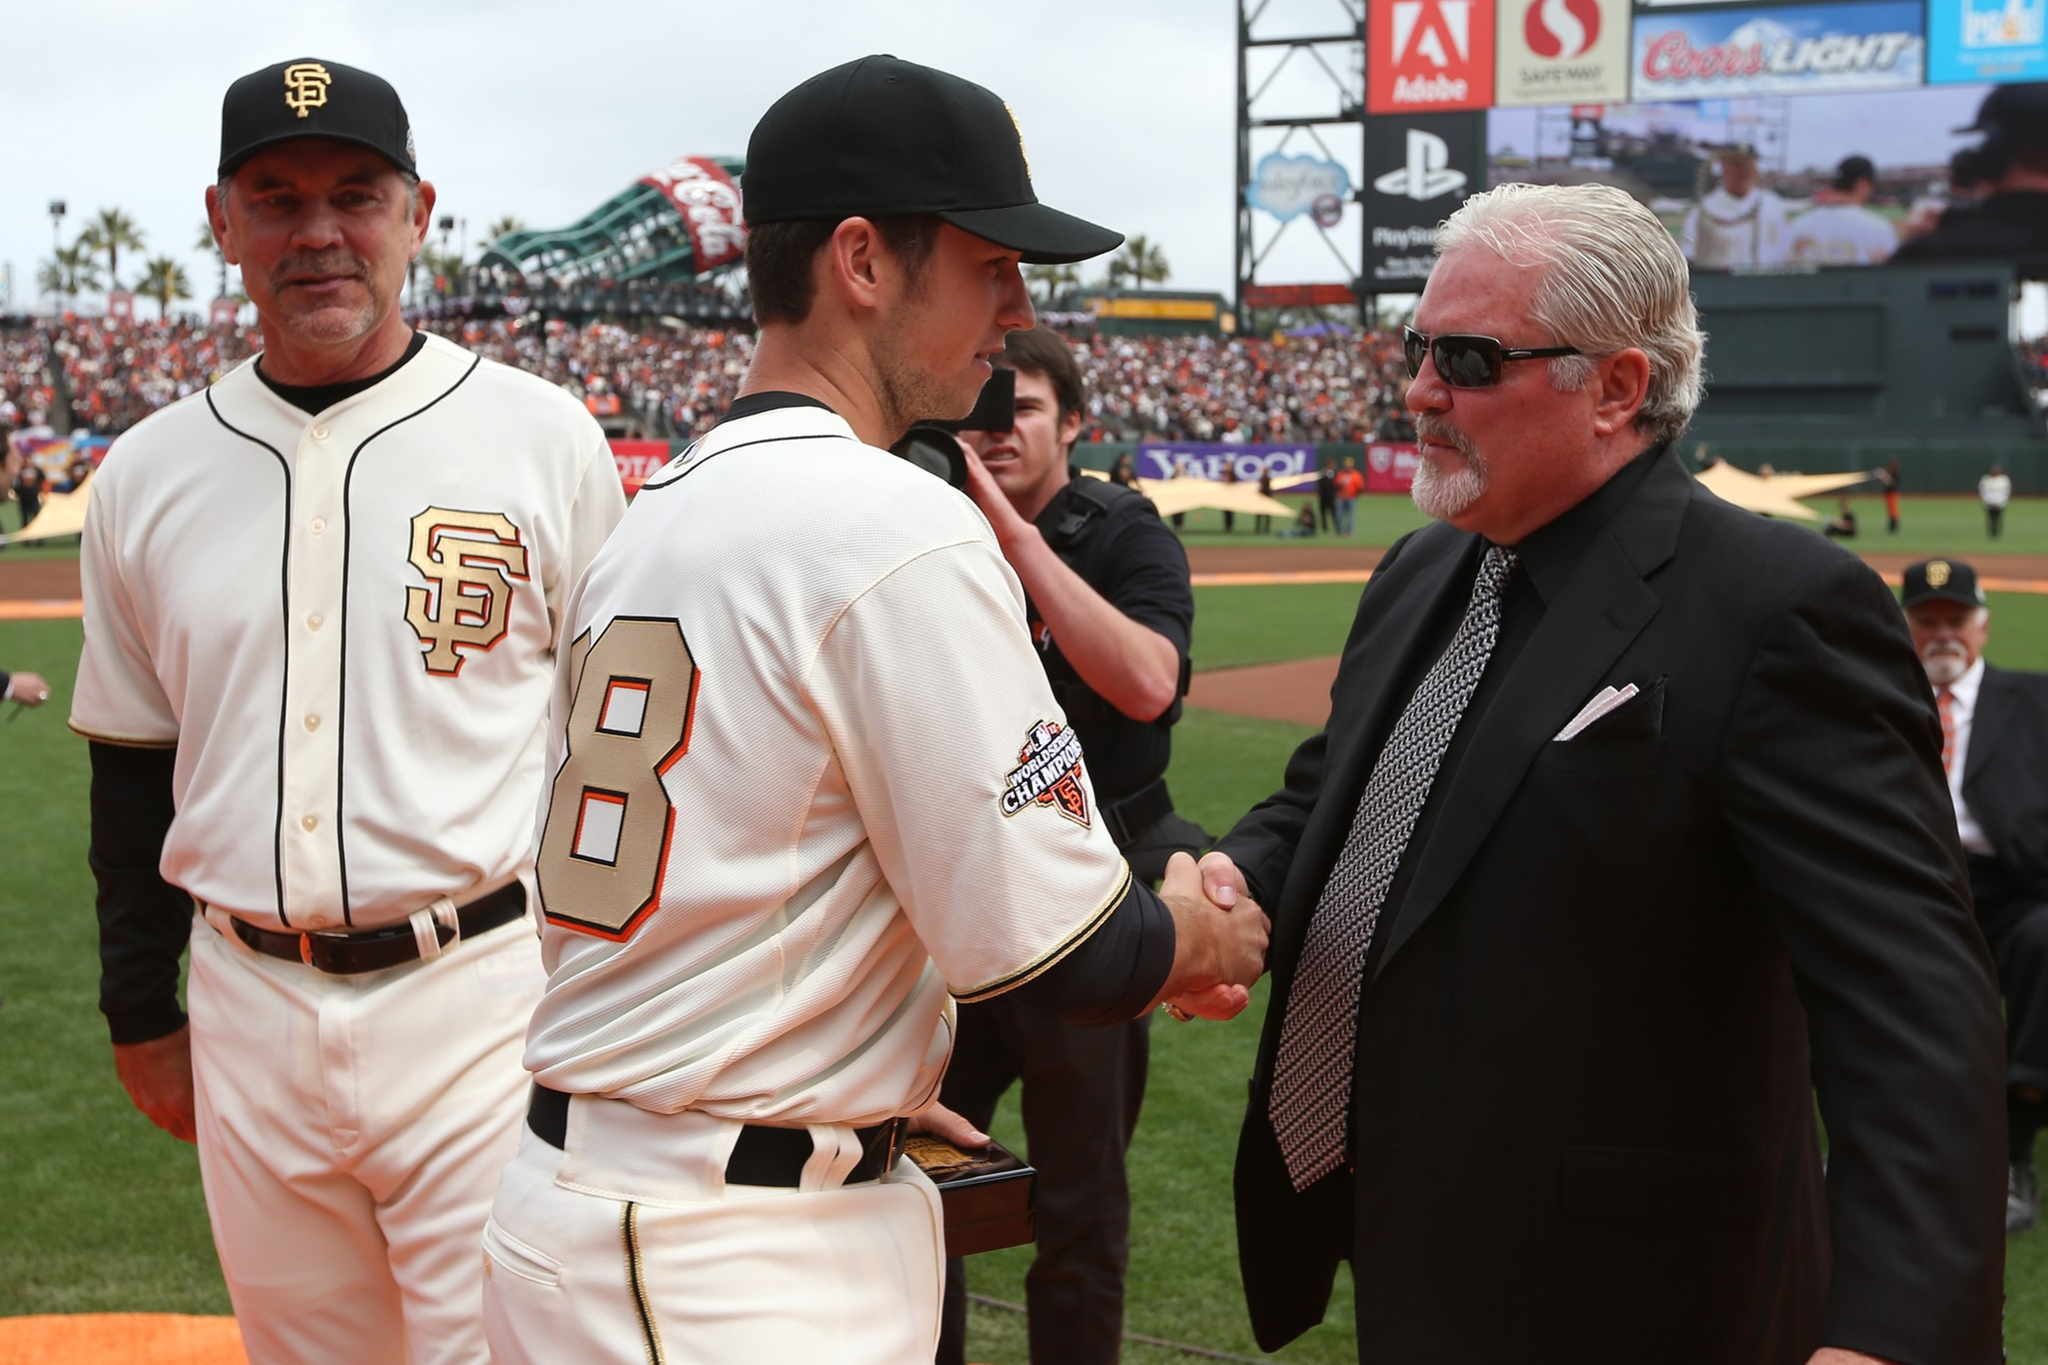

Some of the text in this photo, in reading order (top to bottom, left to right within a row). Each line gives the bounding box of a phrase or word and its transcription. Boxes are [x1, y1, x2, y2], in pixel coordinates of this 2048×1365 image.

[1644, 30, 1912, 81] Coors LIGHT
[284, 63, 332, 118] SF
[1392, 74, 1468, 103] Adobe
[615, 455, 663, 480] OTA
[404, 505, 531, 678] SF
[535, 615, 701, 944] 8
[1010, 749, 1050, 787] WORLD
